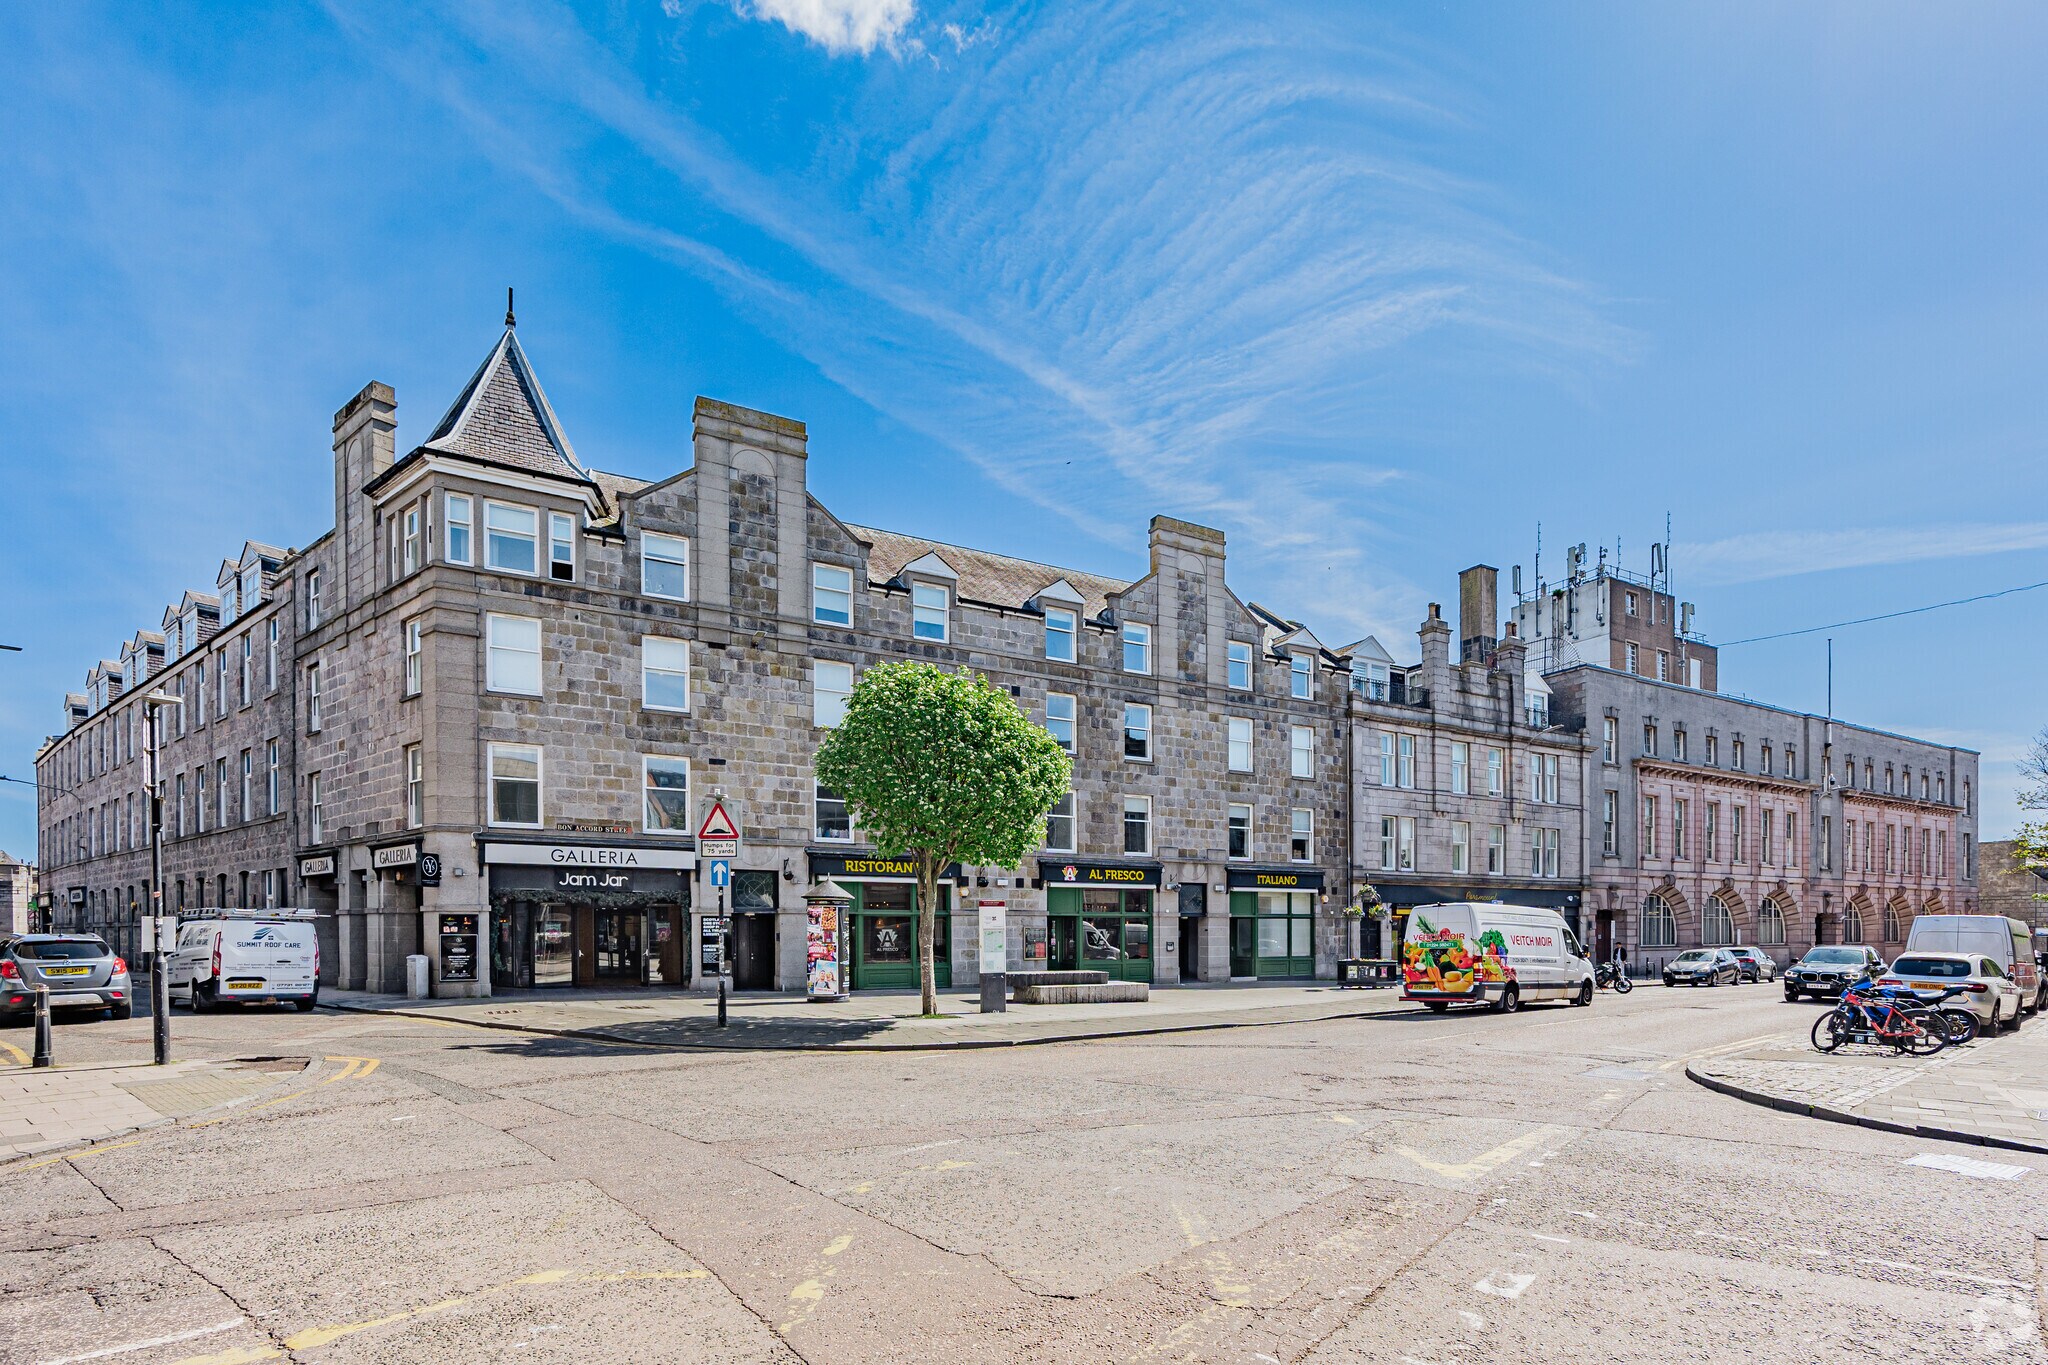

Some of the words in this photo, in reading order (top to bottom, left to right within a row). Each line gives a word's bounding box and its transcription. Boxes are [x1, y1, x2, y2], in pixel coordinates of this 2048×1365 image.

[575, 824, 603, 832] ACCORD
[605, 826, 632, 834] STEE
[380, 848, 412, 864] GALLERIA
[551, 849, 638, 865] GALLERIA
[304, 860, 329, 873] GALLERIA
[845, 860, 919, 873] RISTORAN
[559, 872, 597, 886] Jam
[599, 873, 629, 887] Jar
[1089, 869, 1103, 880] AL
[1105, 869, 1145, 881] FRESCO
[1257, 875, 1297, 885] ITALIANO
[1510, 935, 1535, 946] VEITCH
[1535, 936, 1553, 947] MOIR
